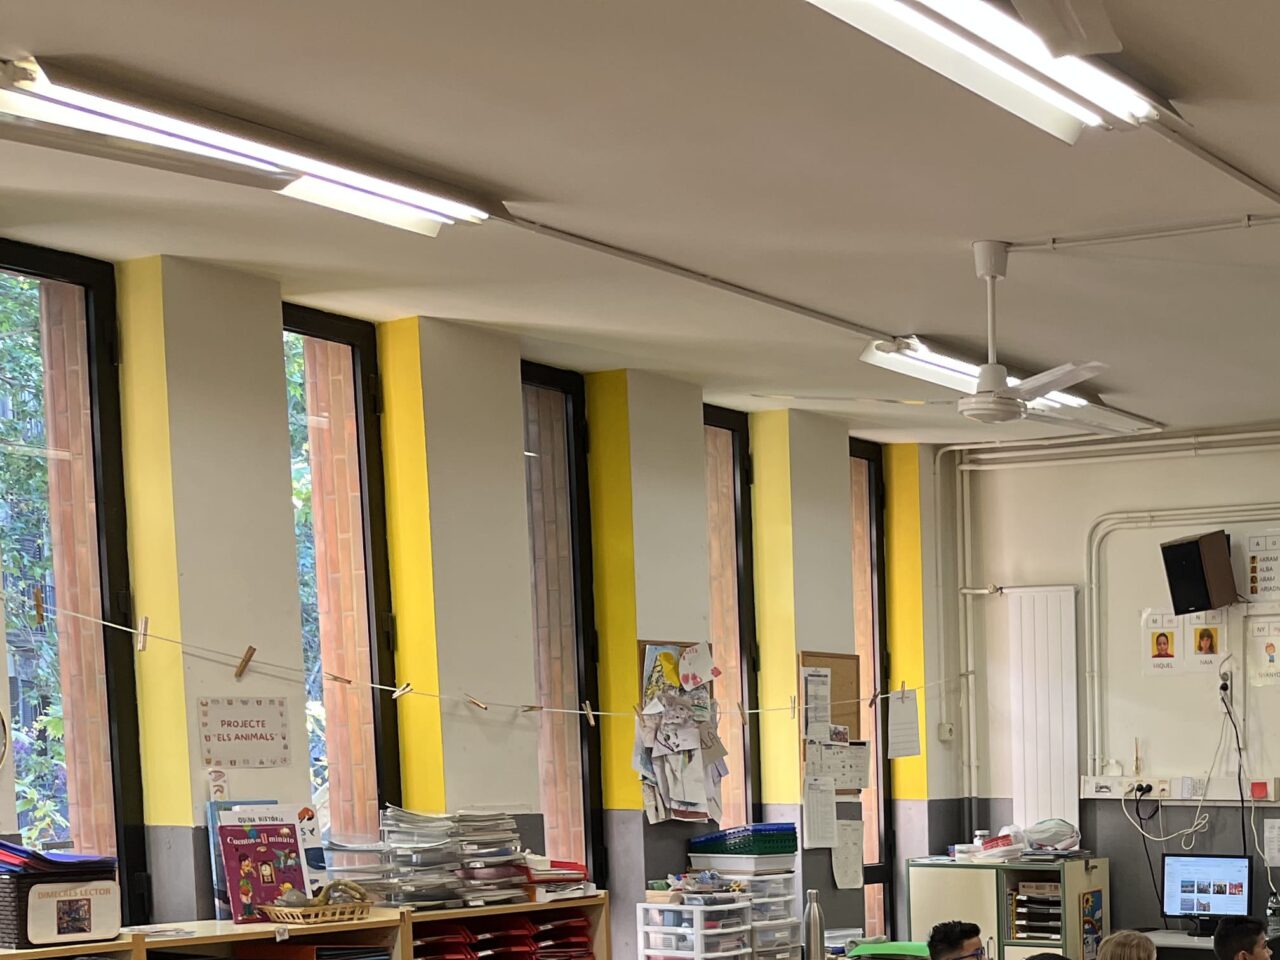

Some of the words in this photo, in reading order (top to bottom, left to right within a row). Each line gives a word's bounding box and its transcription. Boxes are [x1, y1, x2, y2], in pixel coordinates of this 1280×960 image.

[220, 720, 266, 728] PROJECTE
[227, 836, 255, 845] Cuentos
[269, 835, 294, 844] minuto
[38, 888, 78, 898] DIMECRES
[80, 888, 111, 897] LECTOR
